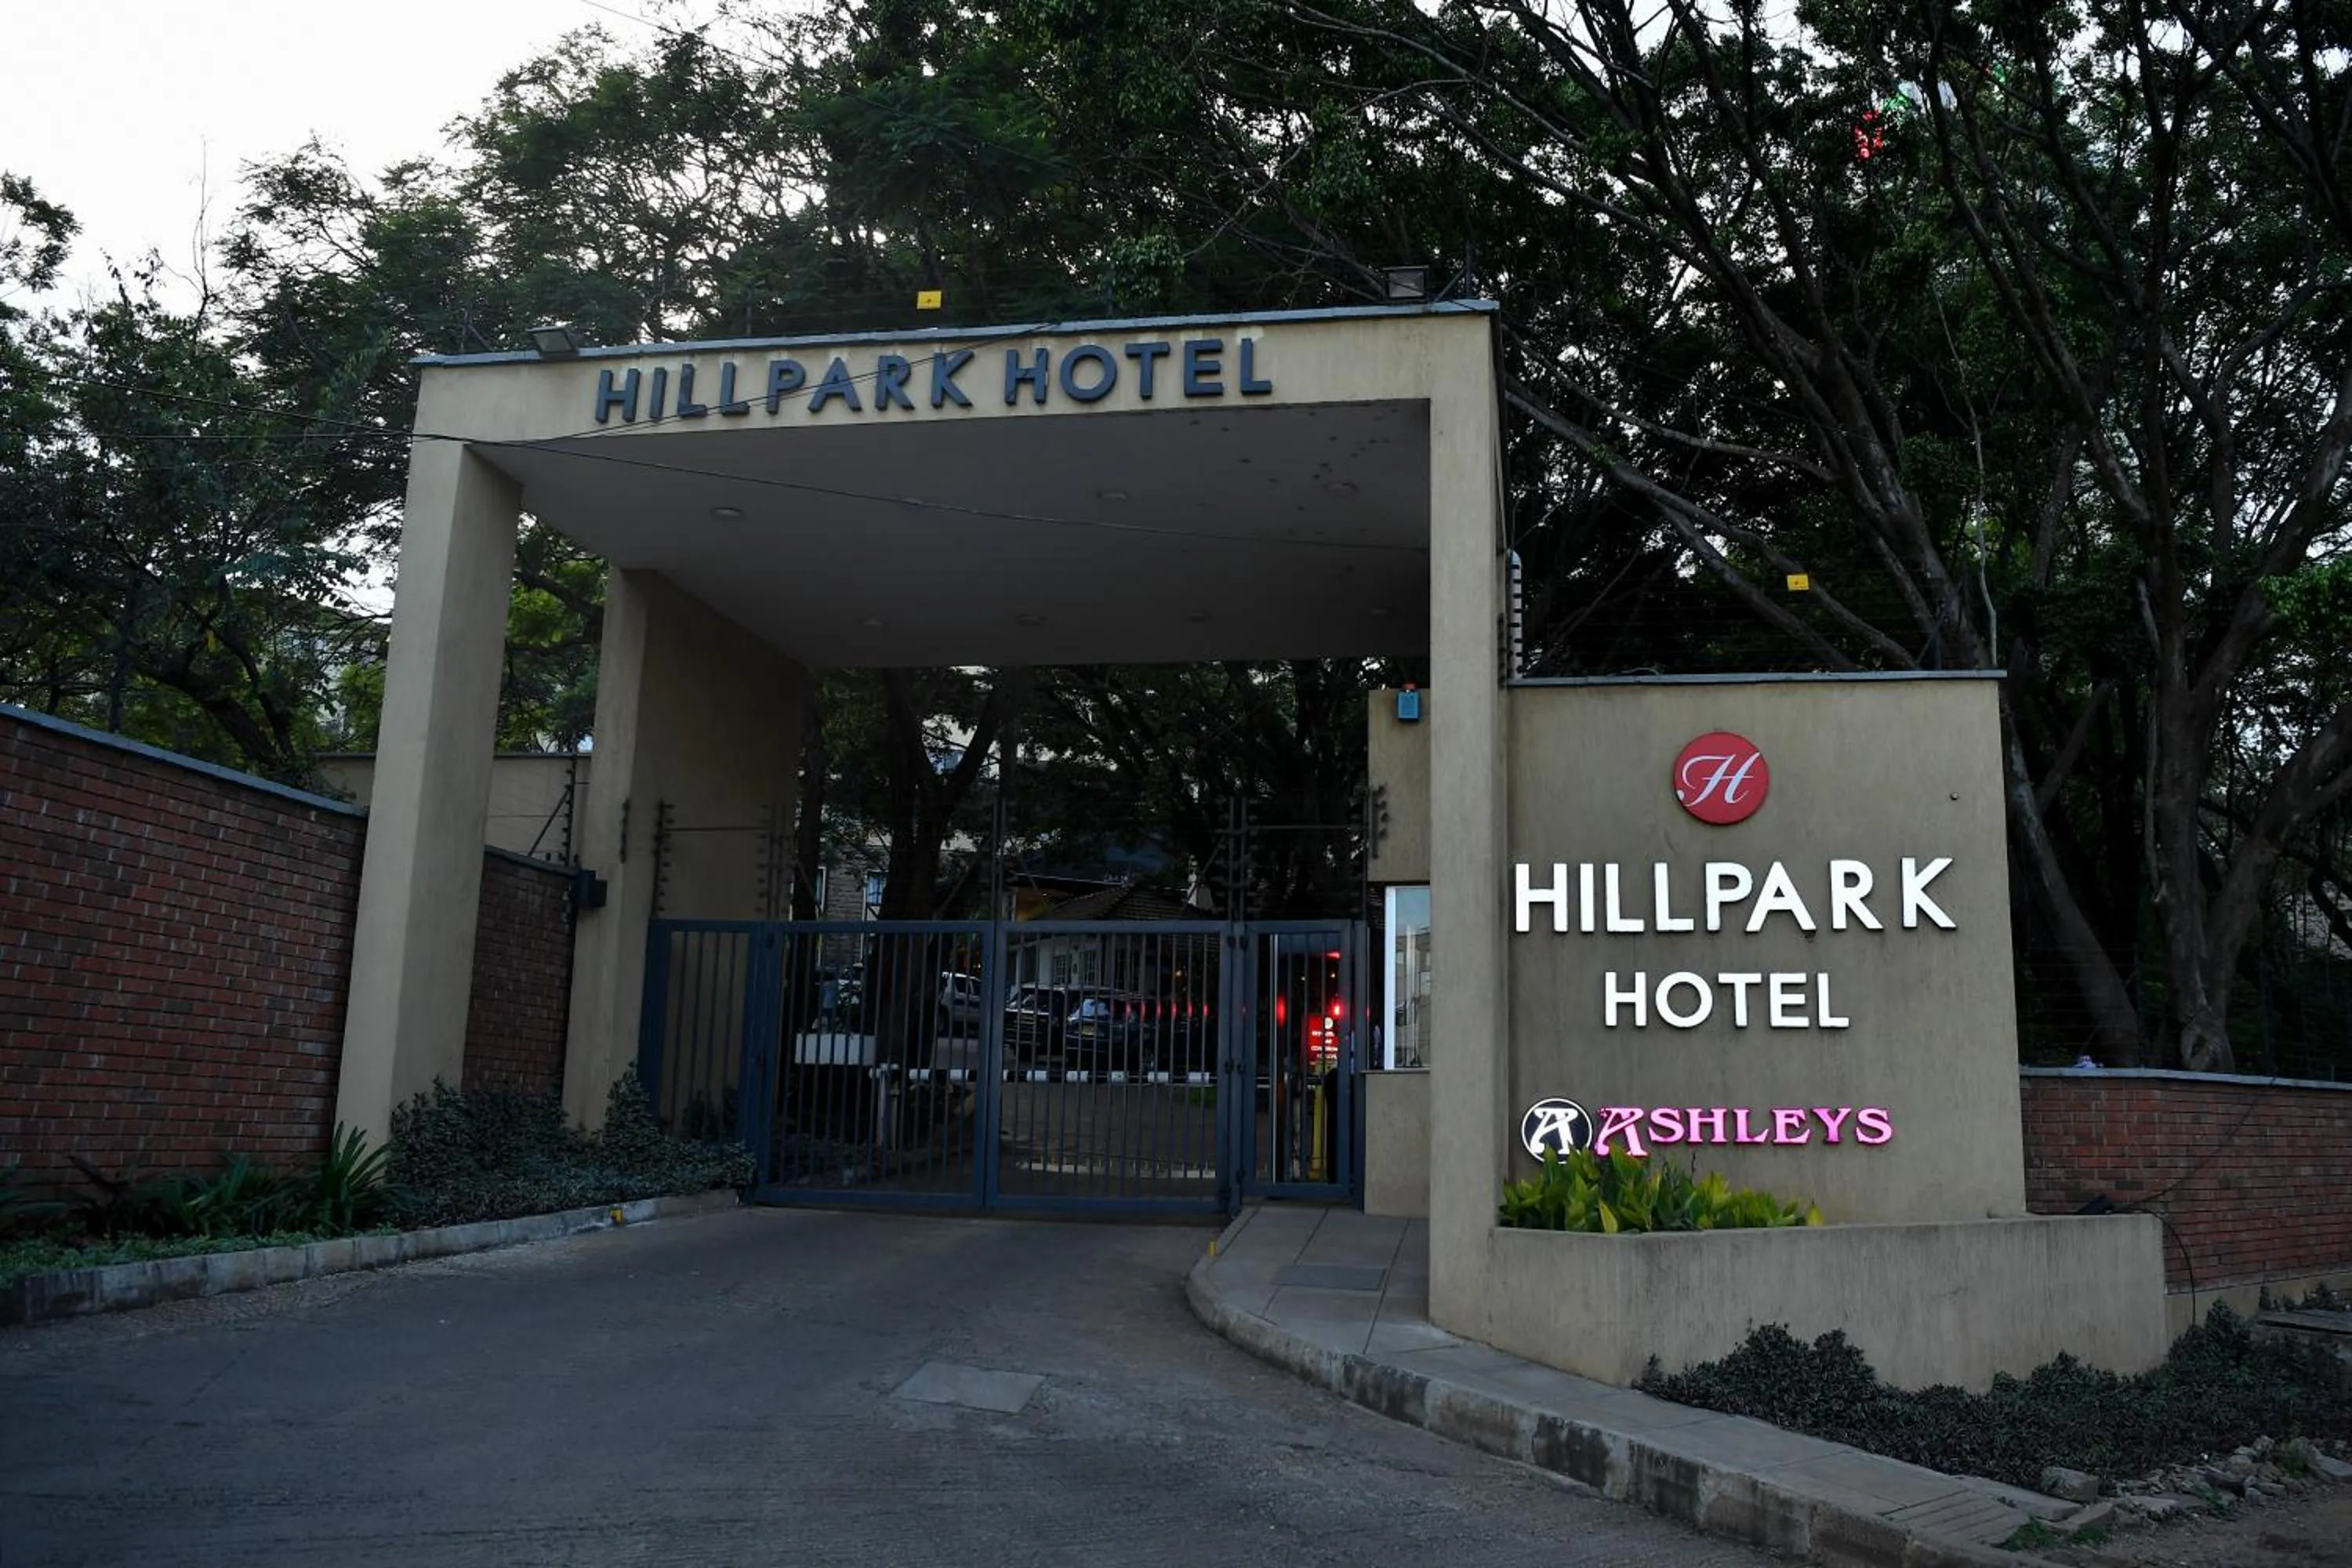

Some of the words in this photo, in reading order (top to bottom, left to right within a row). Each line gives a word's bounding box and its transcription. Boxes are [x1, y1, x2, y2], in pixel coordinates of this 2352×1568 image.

[595, 350, 974, 424] HILLPARK
[1004, 337, 1273, 405] HOTEL
[1515, 856, 1958, 933] HILLPARK
[1604, 971, 1850, 1029] HOTEL
[1594, 1106, 1894, 1158] ASHLEYS
